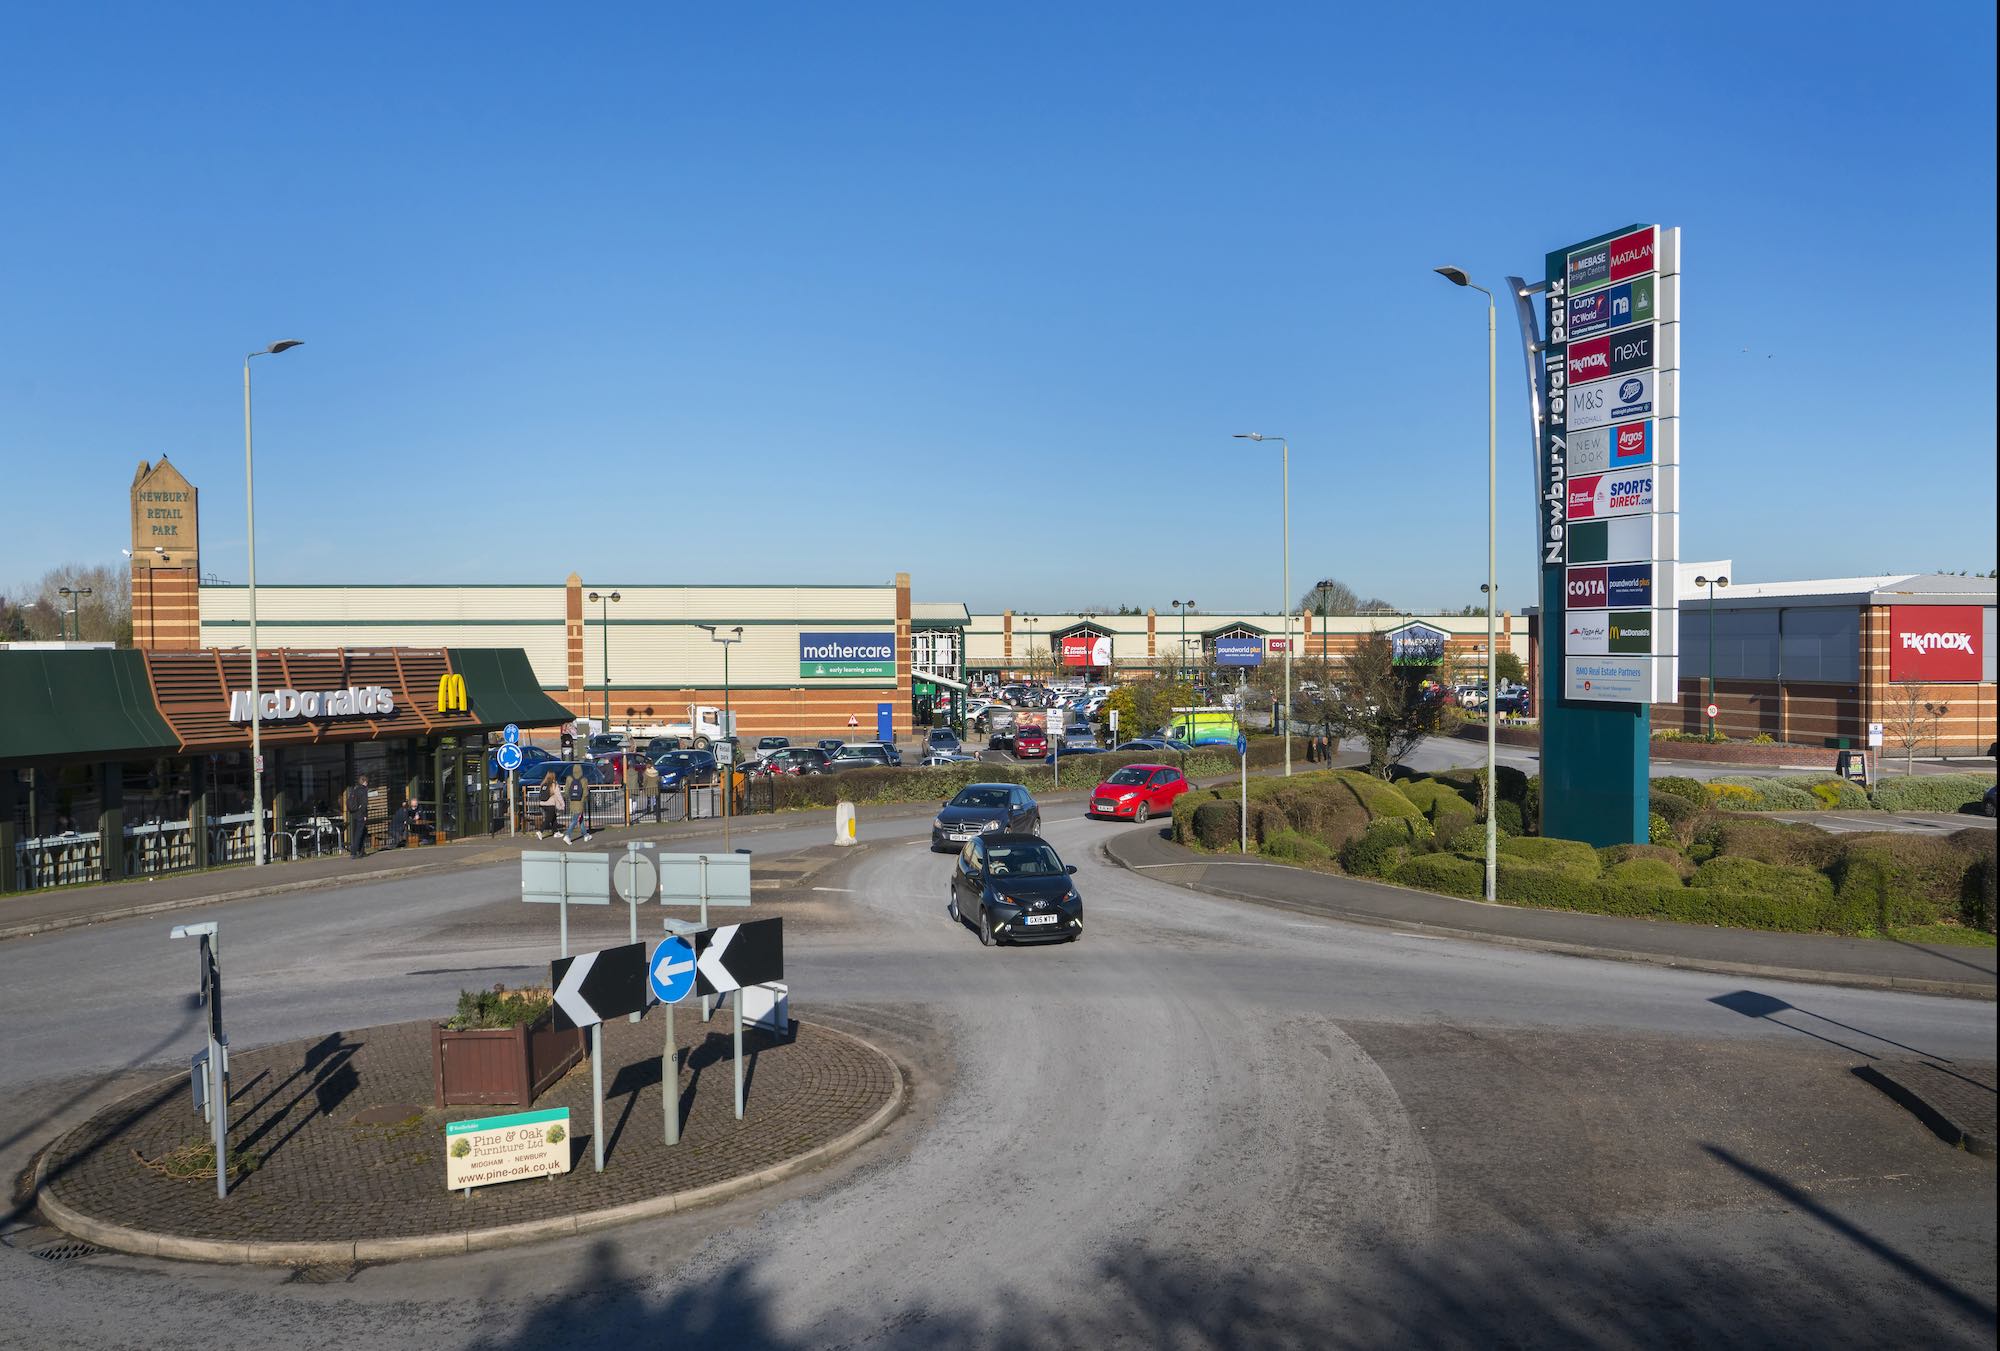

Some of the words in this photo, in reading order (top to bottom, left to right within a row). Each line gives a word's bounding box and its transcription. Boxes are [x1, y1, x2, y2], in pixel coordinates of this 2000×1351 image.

[1569, 253, 1606, 272] HOMEBASE
[1611, 243, 1654, 267] MATALAN
[1570, 270, 1586, 282] Design
[1588, 264, 1606, 276] Centre
[1546, 278, 1566, 344] park
[1574, 296, 1595, 310] Currys
[1572, 314, 1582, 324] PC
[1582, 310, 1596, 322] World
[1615, 340, 1648, 362] next
[1546, 354, 1564, 424] retail
[1574, 389, 1604, 413] M&S
[1576, 438, 1600, 451] NEW
[1620, 431, 1642, 445] Argos
[1574, 451, 1603, 465] LOOK
[1610, 478, 1652, 496] SPORTS
[139, 492, 189, 502] NEWBURY
[1545, 435, 1566, 564] Newbury
[147, 509, 183, 518] RETAIL
[152, 525, 178, 535] PARK
[1569, 580, 1605, 596] COSTA
[1610, 579, 1639, 589] poundworld
[1640, 579, 1650, 588] plus
[1582, 628, 1594, 636] Pizza
[804, 642, 891, 658] mothercare
[1589, 666, 1600, 675] Real
[1601, 667, 1616, 676] Estate
[1618, 668, 1640, 676] Partners
[230, 686, 394, 721] McDonald's
[473, 1135, 501, 1147] Pine
[506, 1132, 516, 1142] &
[520, 1128, 543, 1140] Oak
[474, 1142, 524, 1157] Furniture
[528, 1139, 543, 1149] Ltd
[471, 1159, 504, 1169] MIDGHAM
[515, 1152, 547, 1162] NEWBURY
[458, 1160, 560, 1184] www.pine-oak.co.uk
